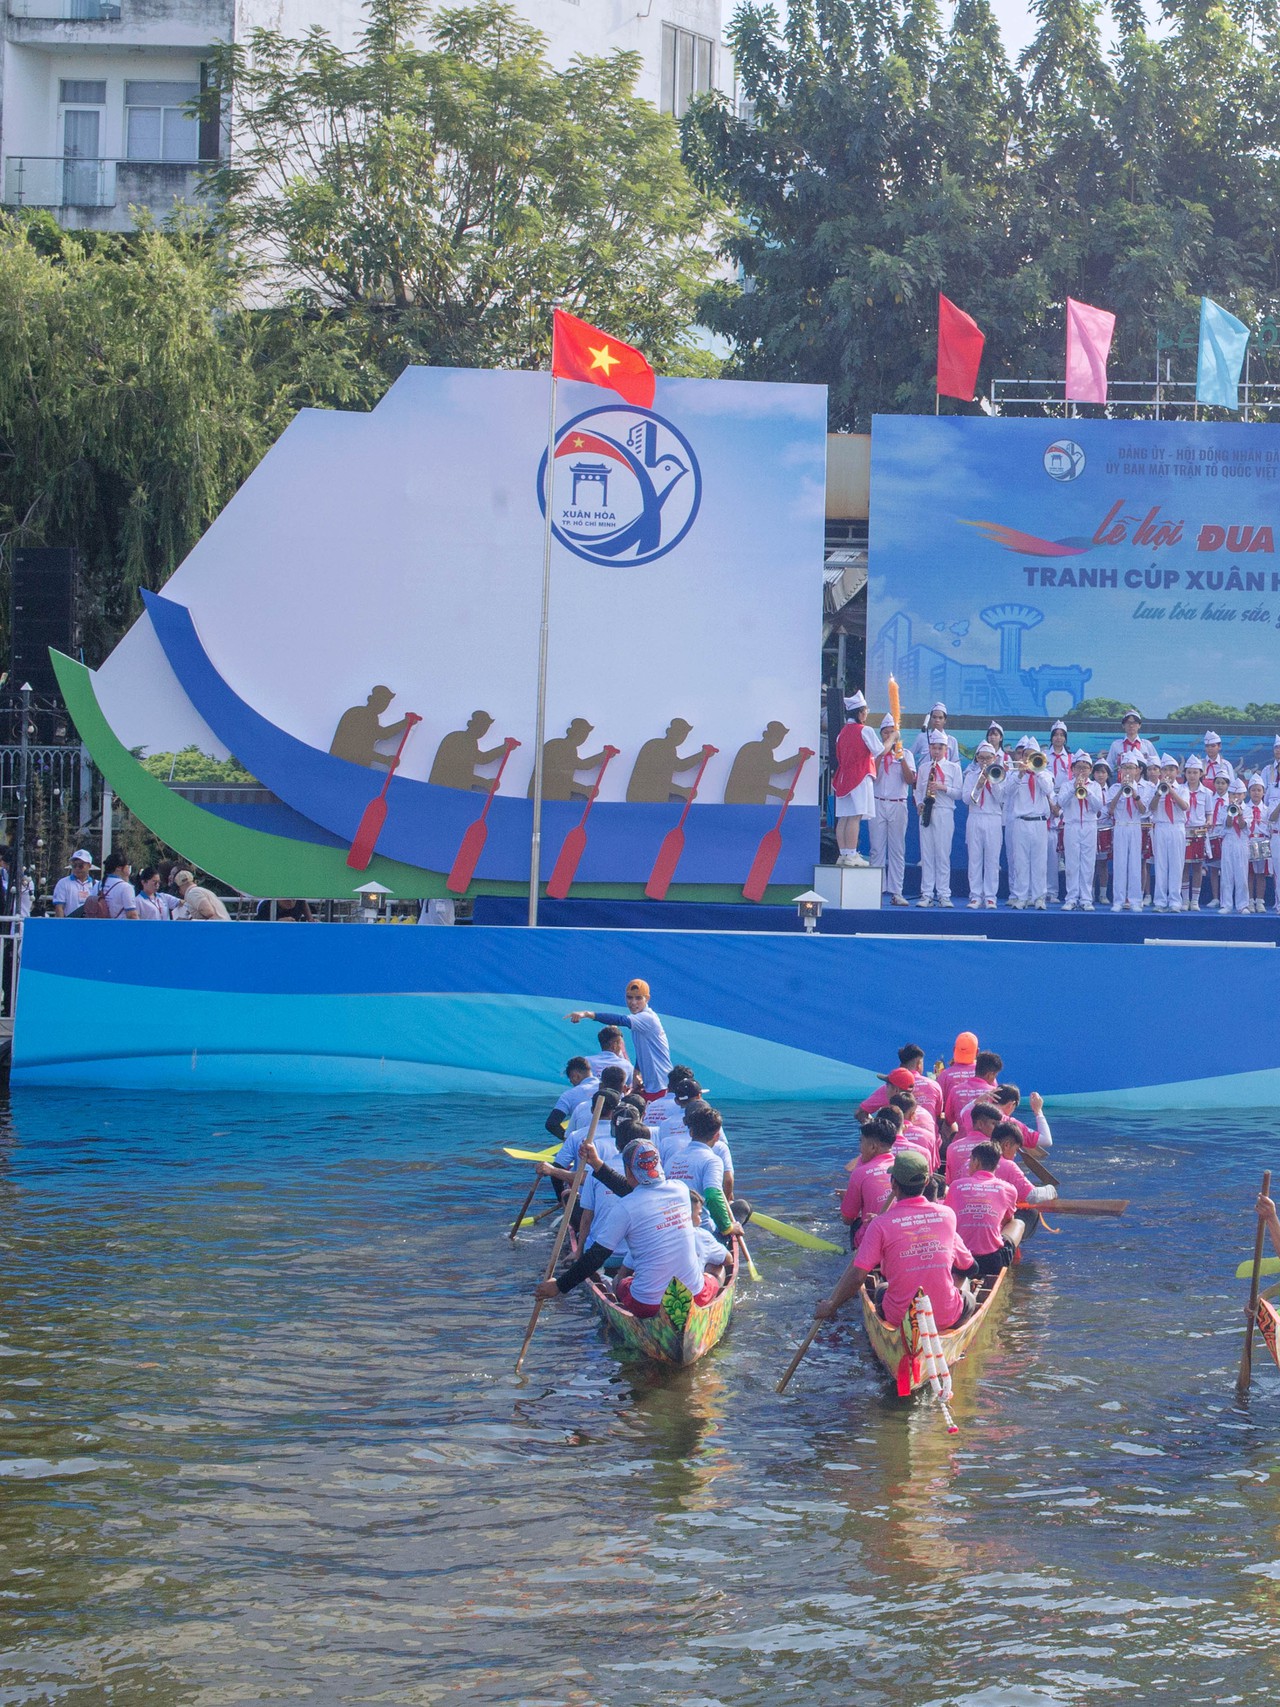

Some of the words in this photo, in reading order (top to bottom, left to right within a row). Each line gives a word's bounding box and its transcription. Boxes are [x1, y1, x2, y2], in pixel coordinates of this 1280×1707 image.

[1118, 444, 1148, 460] ĐẢNG
[1176, 447, 1196, 463] HỘI
[1199, 446, 1229, 462] ĐỒNG
[1232, 448, 1262, 462] NHÂN
[1123, 462, 1145, 475] BAN
[1148, 461, 1170, 479] MẶT
[1173, 461, 1201, 479] TRẬN
[1221, 463, 1252, 478] QUỐC
[1255, 464, 1278, 480] VIỆT
[562, 509, 591, 519] XUÂN
[1131, 505, 1185, 551] hội
[1196, 524, 1275, 553] ĐUA
[1023, 566, 1118, 588] TRANH
[1124, 562, 1180, 590] CÚP
[1185, 565, 1265, 592] XUÂN
